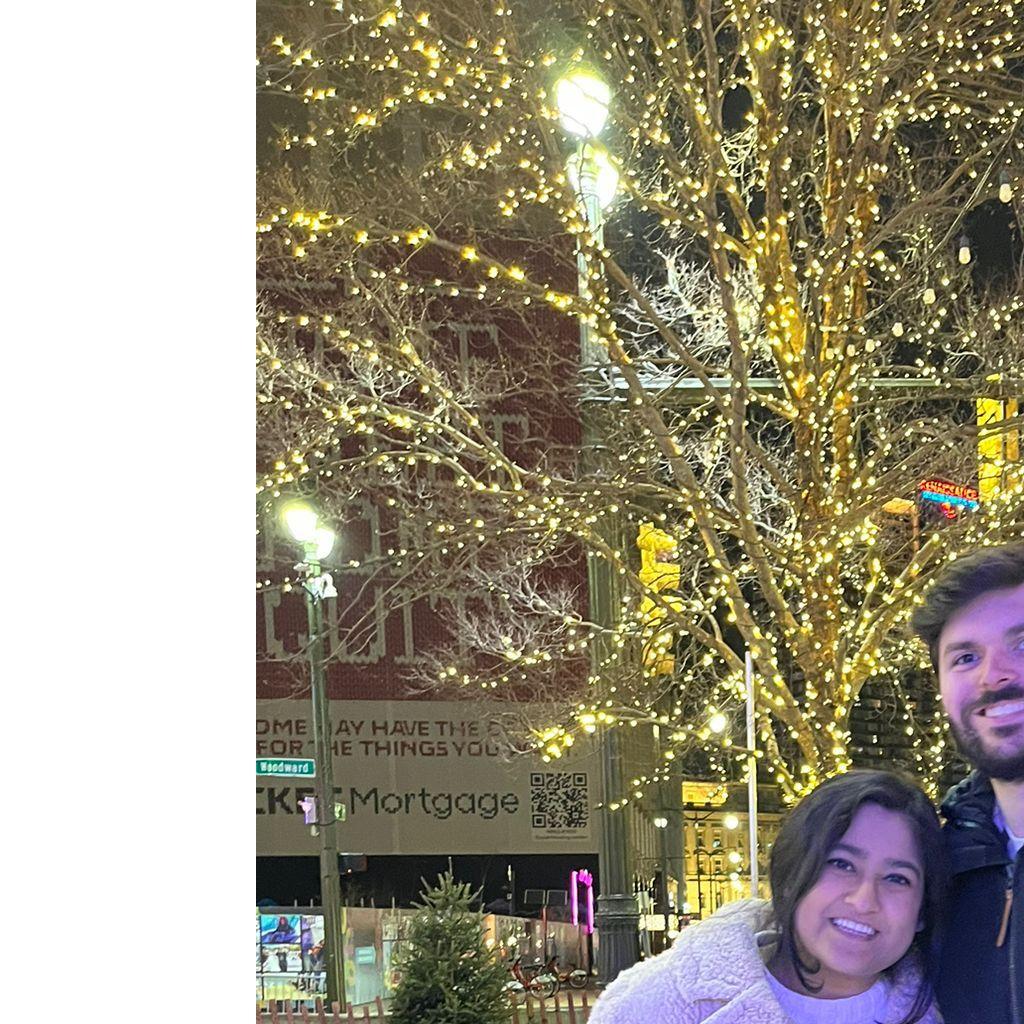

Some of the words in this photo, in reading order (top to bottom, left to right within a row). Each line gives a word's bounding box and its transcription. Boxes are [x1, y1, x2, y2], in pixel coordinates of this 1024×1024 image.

[328, 720, 364, 735] AY
[372, 720, 430, 736] HAVE
[256, 740, 303, 756] FOR
[360, 740, 449, 756] THINGS
[452, 741, 499, 756] YOU
[260, 761, 309, 773] Woodward
[351, 785, 519, 820] Mortgage
